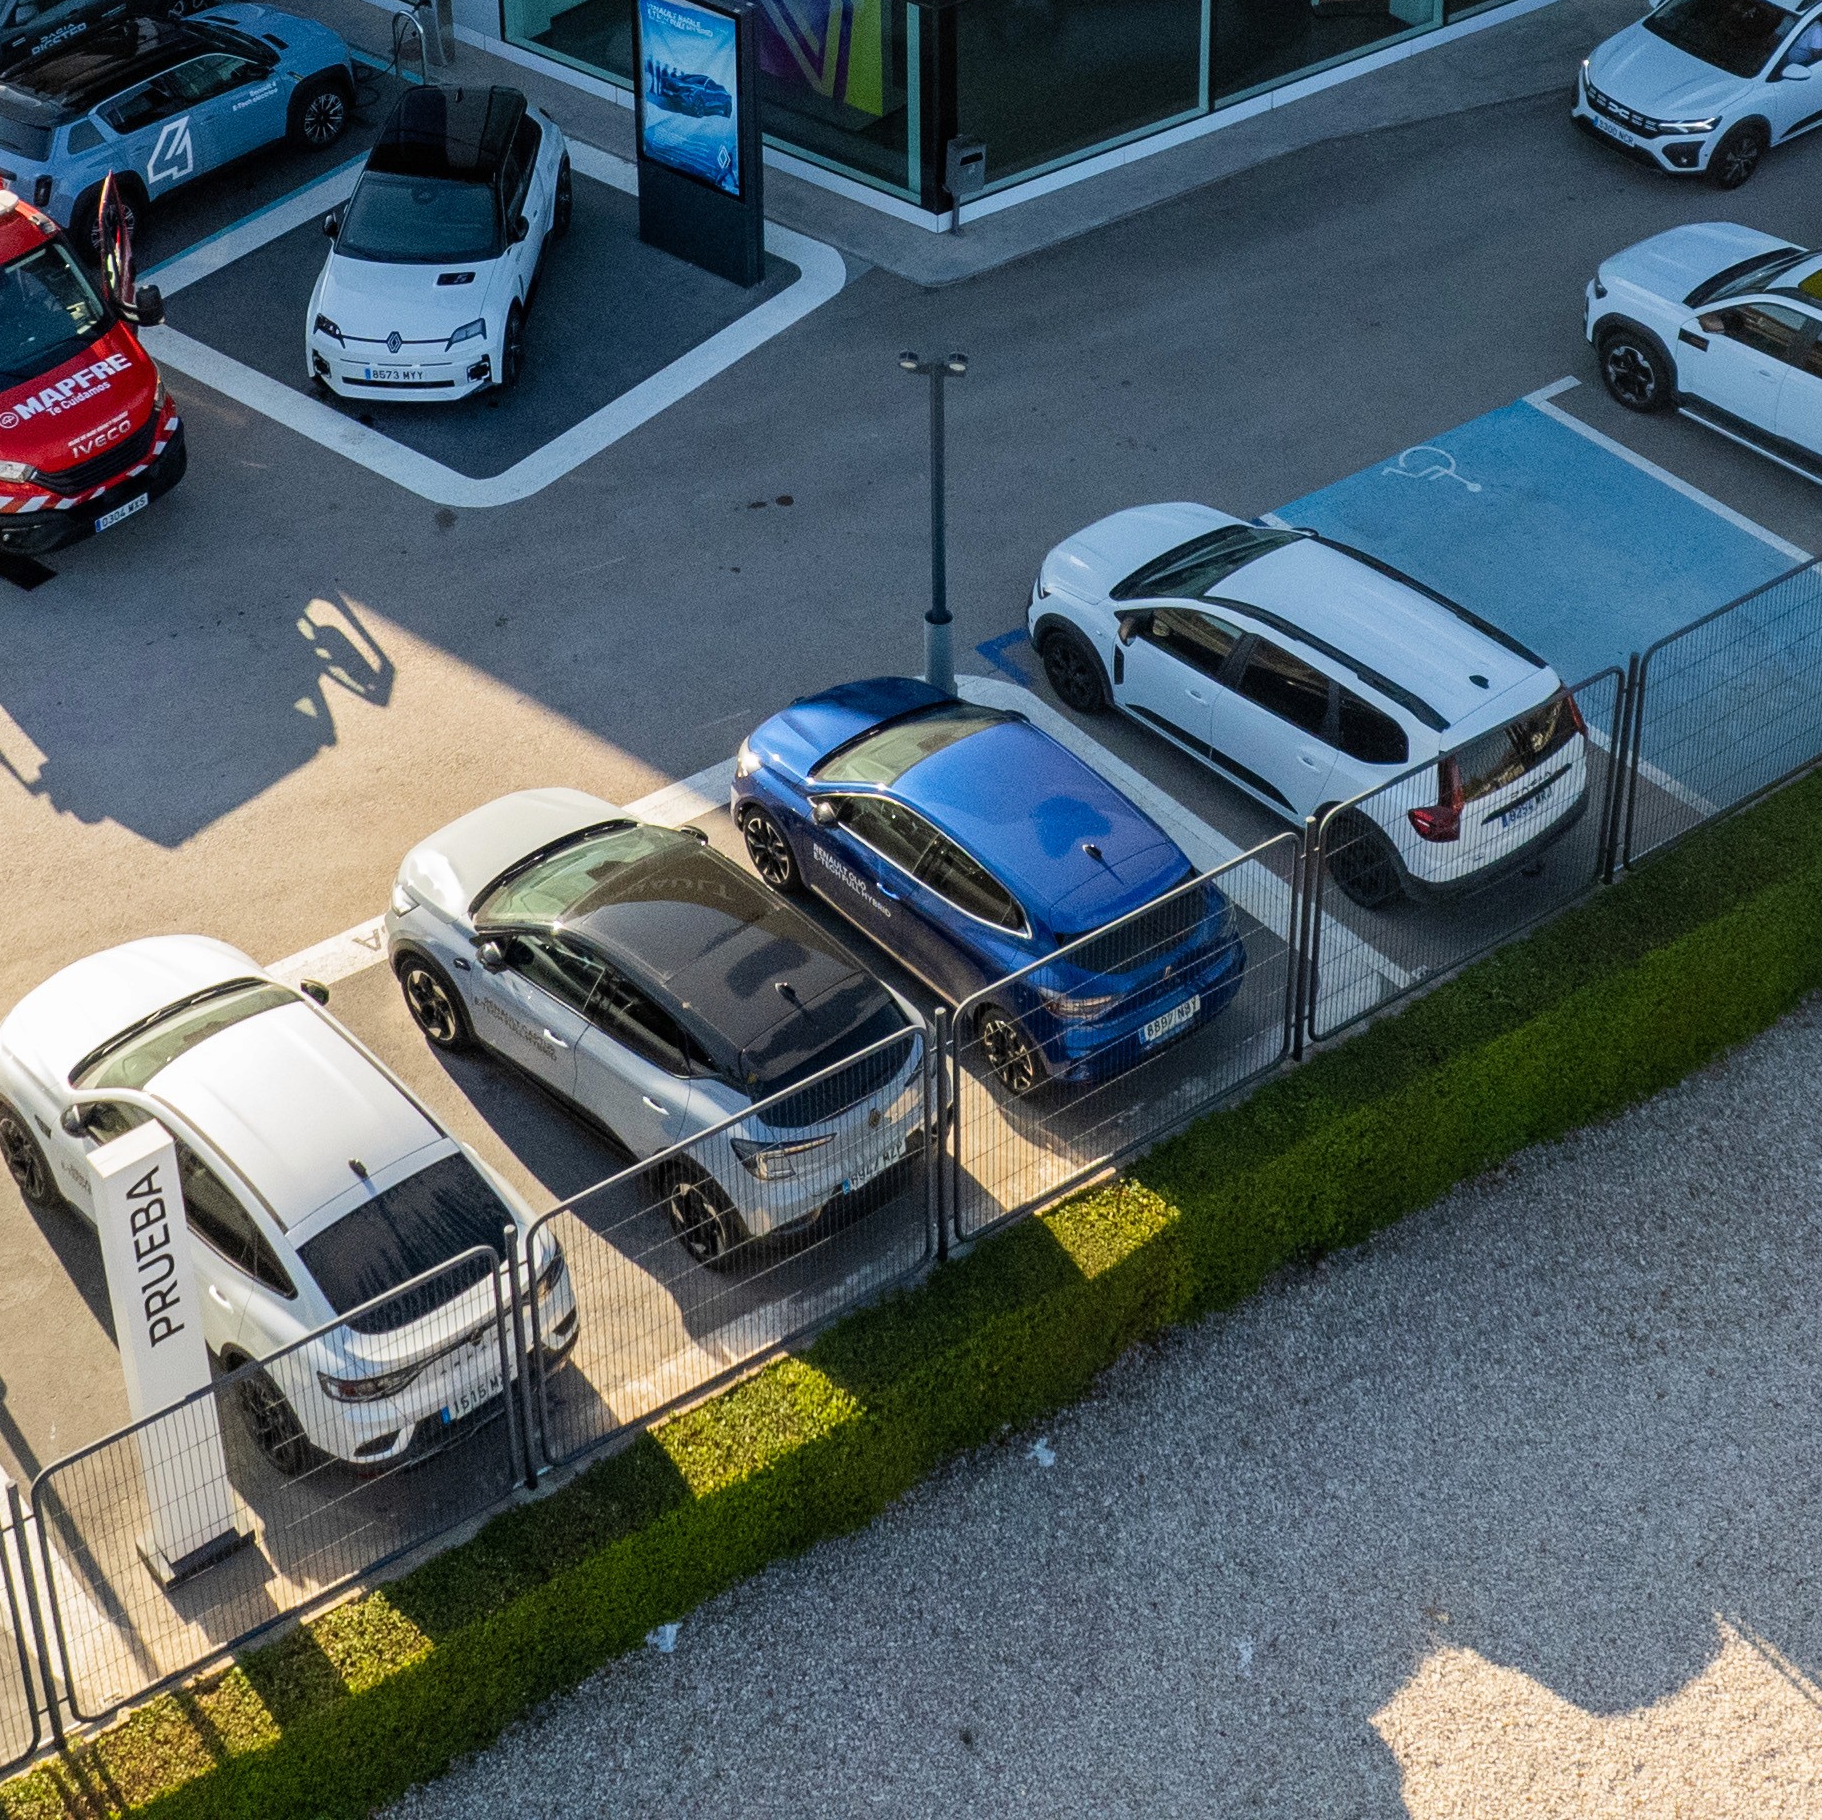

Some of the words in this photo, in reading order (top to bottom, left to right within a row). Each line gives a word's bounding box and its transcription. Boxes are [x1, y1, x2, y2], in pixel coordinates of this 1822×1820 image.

[13, 353, 132, 420] MAPFRE
[372, 370, 400, 380] 8573
[45, 405, 62, 417] Te
[60, 381, 111, 410] Cuidamos
[71, 419, 132, 459] IVECO
[102, 507, 127, 528] 0304
[813, 843, 848, 875] RENAULT
[848, 872, 867, 891] CLIO
[841, 874, 861, 894] FULL
[861, 889, 892, 918] HYBRID
[126, 1165, 185, 1348] PRUEBA
